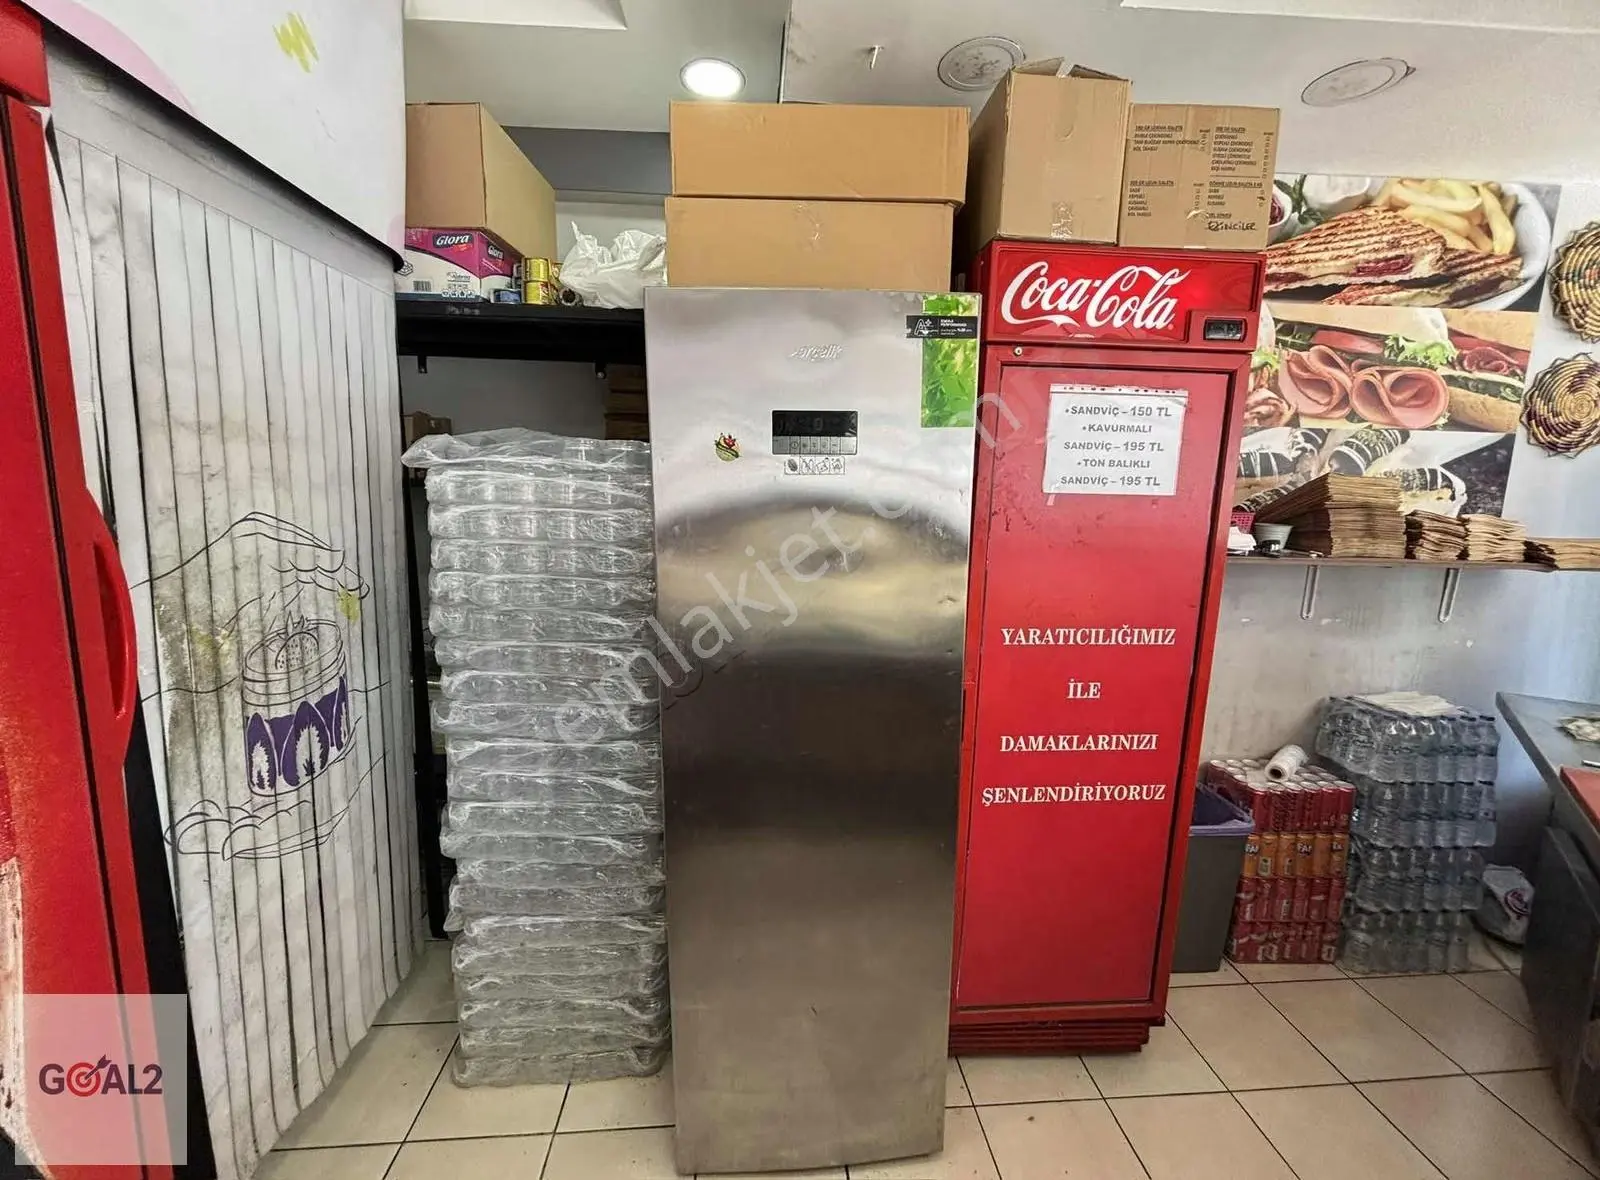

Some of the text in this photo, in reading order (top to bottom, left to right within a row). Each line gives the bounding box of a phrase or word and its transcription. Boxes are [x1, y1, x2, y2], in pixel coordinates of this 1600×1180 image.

[436, 234, 470, 246] Glora
[1001, 261, 1191, 330] Coca-Cola
[1070, 405, 1119, 417] SANDVİÇ
[1130, 406, 1153, 417] 150
[1156, 407, 1172, 417] TL
[1088, 423, 1152, 434] KAVURMALI
[1064, 440, 1112, 452] SANDVİÇ
[1123, 441, 1146, 452] 195
[1149, 442, 1164, 452] TL
[1083, 458, 1151, 469] TON BALIKLI
[1060, 475, 1109, 487] SANDVİÇ
[1119, 476, 1142, 486] 195
[1144, 476, 1161, 486] TL
[1001, 624, 1177, 646] YARATICILIĞIMIZ
[1066, 678, 1101, 699] İLE
[1000, 734, 1159, 752] DAMAKLARINIZI
[982, 782, 1167, 807] ŞENLENDİRİYORUZ
